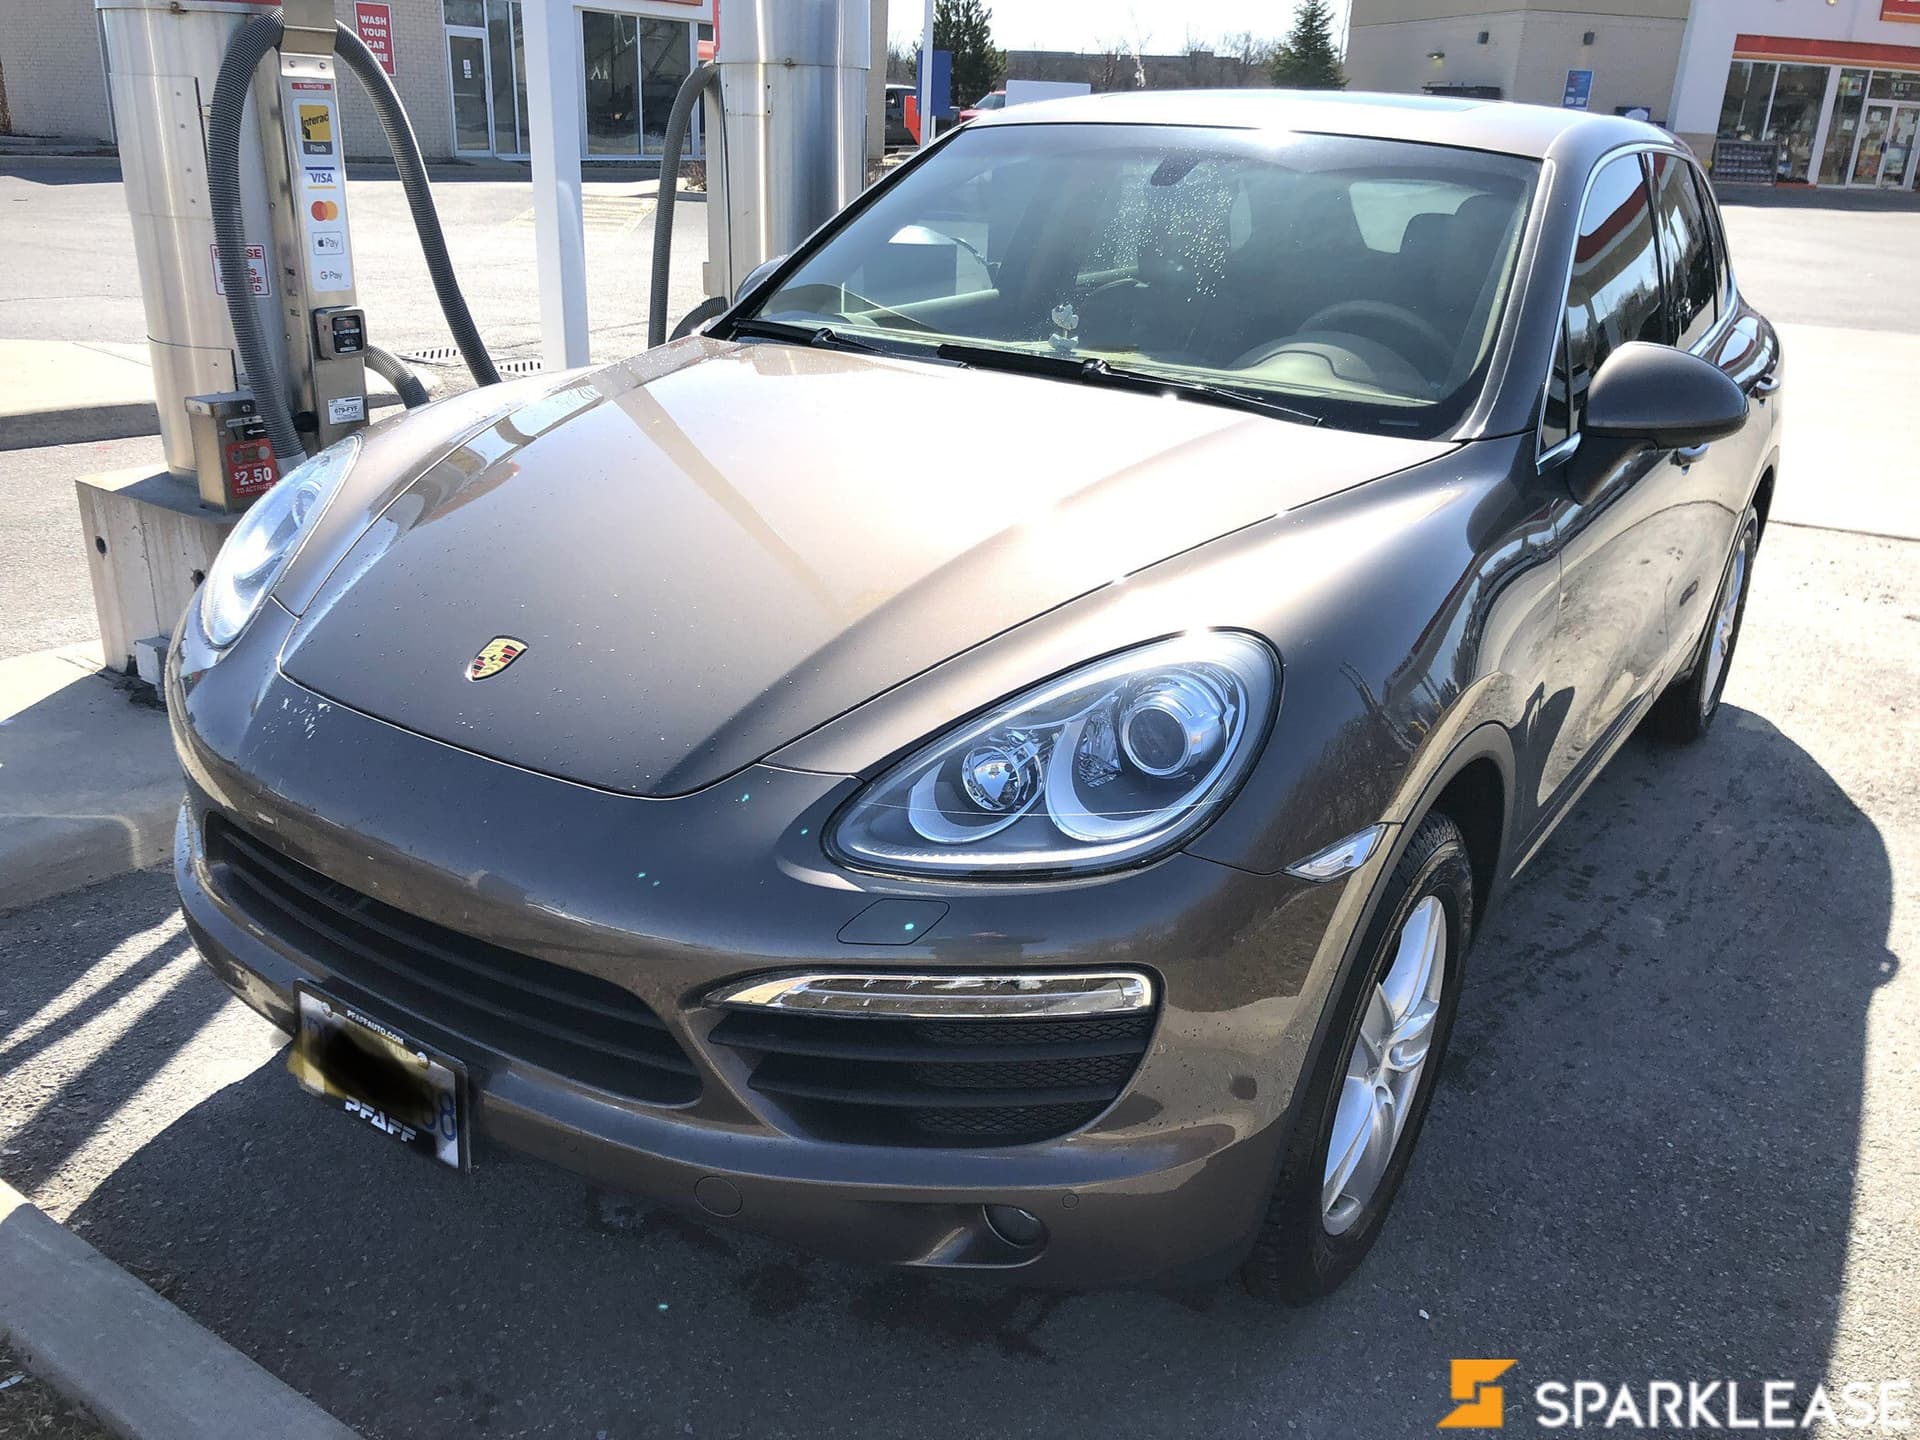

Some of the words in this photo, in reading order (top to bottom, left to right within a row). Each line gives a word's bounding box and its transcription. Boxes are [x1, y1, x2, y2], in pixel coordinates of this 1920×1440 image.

[360, 15, 387, 25] WASH
[362, 28, 387, 37] YOUR
[366, 40, 385, 49] CAR
[310, 144, 327, 152] Flash
[310, 173, 334, 183] VISA
[325, 237, 339, 248] Pay
[329, 271, 343, 280] Pay
[234, 467, 272, 485] $2.50
[346, 1010, 404, 1045] PFAFFAUTO.COM
[345, 1095, 417, 1142] PFAFF
